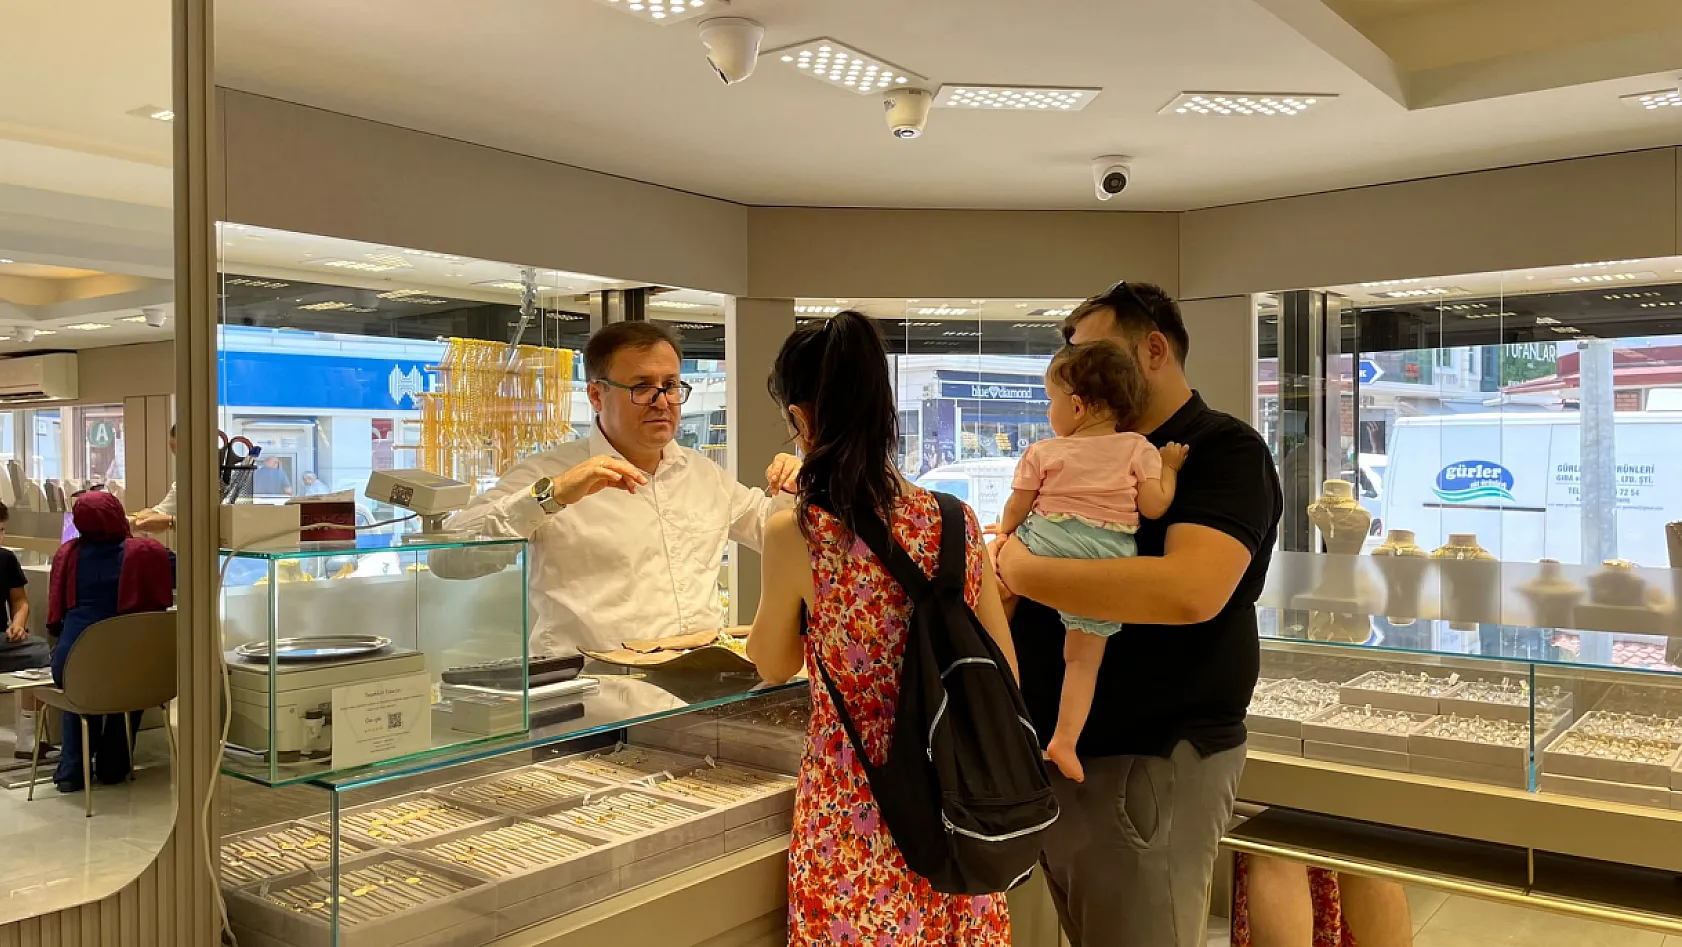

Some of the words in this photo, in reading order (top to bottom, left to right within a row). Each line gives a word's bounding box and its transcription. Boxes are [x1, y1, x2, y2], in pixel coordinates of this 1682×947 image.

[971, 385, 989, 397] blue
[999, 386, 1032, 398] diamond
[96, 423, 109, 441] A
[1445, 464, 1502, 480] gürler
[1616, 463, 1655, 474] RÜNLERİ
